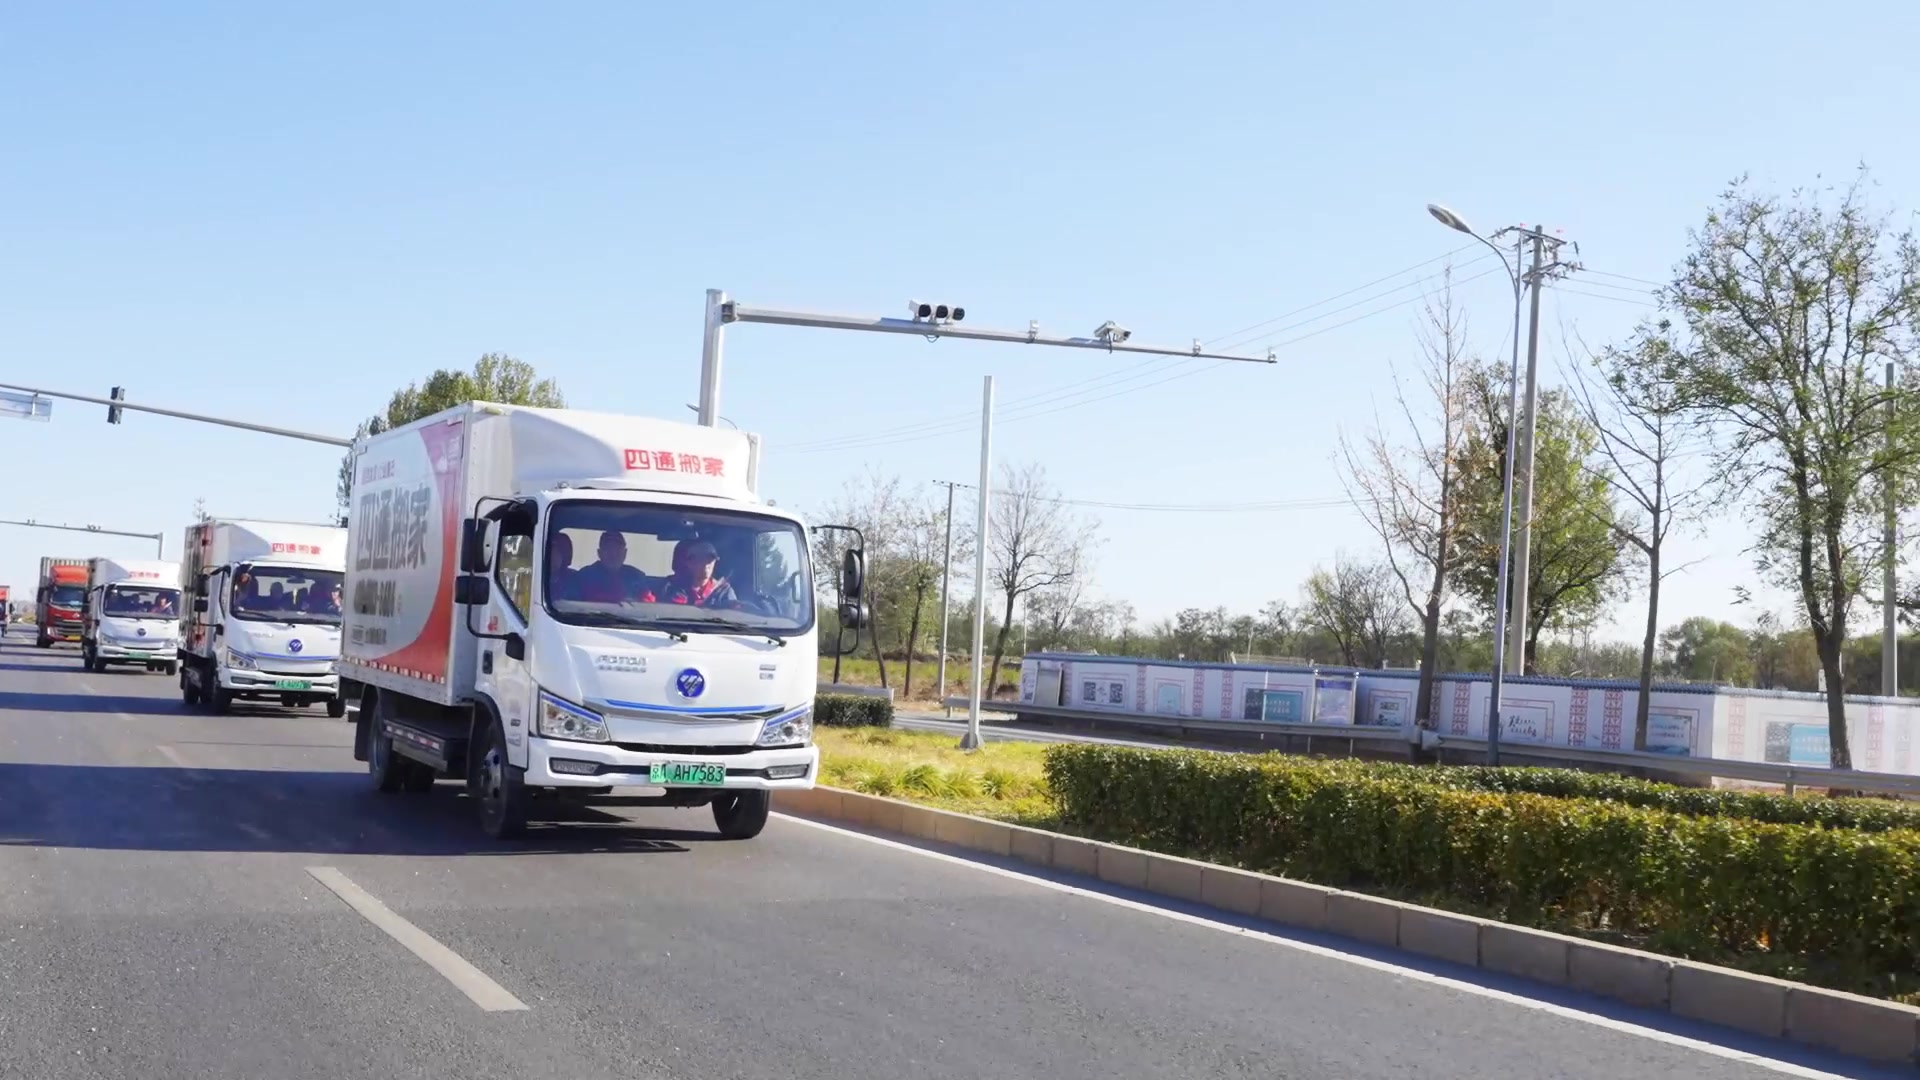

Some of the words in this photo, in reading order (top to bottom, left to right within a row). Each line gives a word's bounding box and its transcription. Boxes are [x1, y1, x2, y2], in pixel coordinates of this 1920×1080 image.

[624, 449, 724, 477] 四通搬家
[357, 484, 430, 571] 四通搬家
